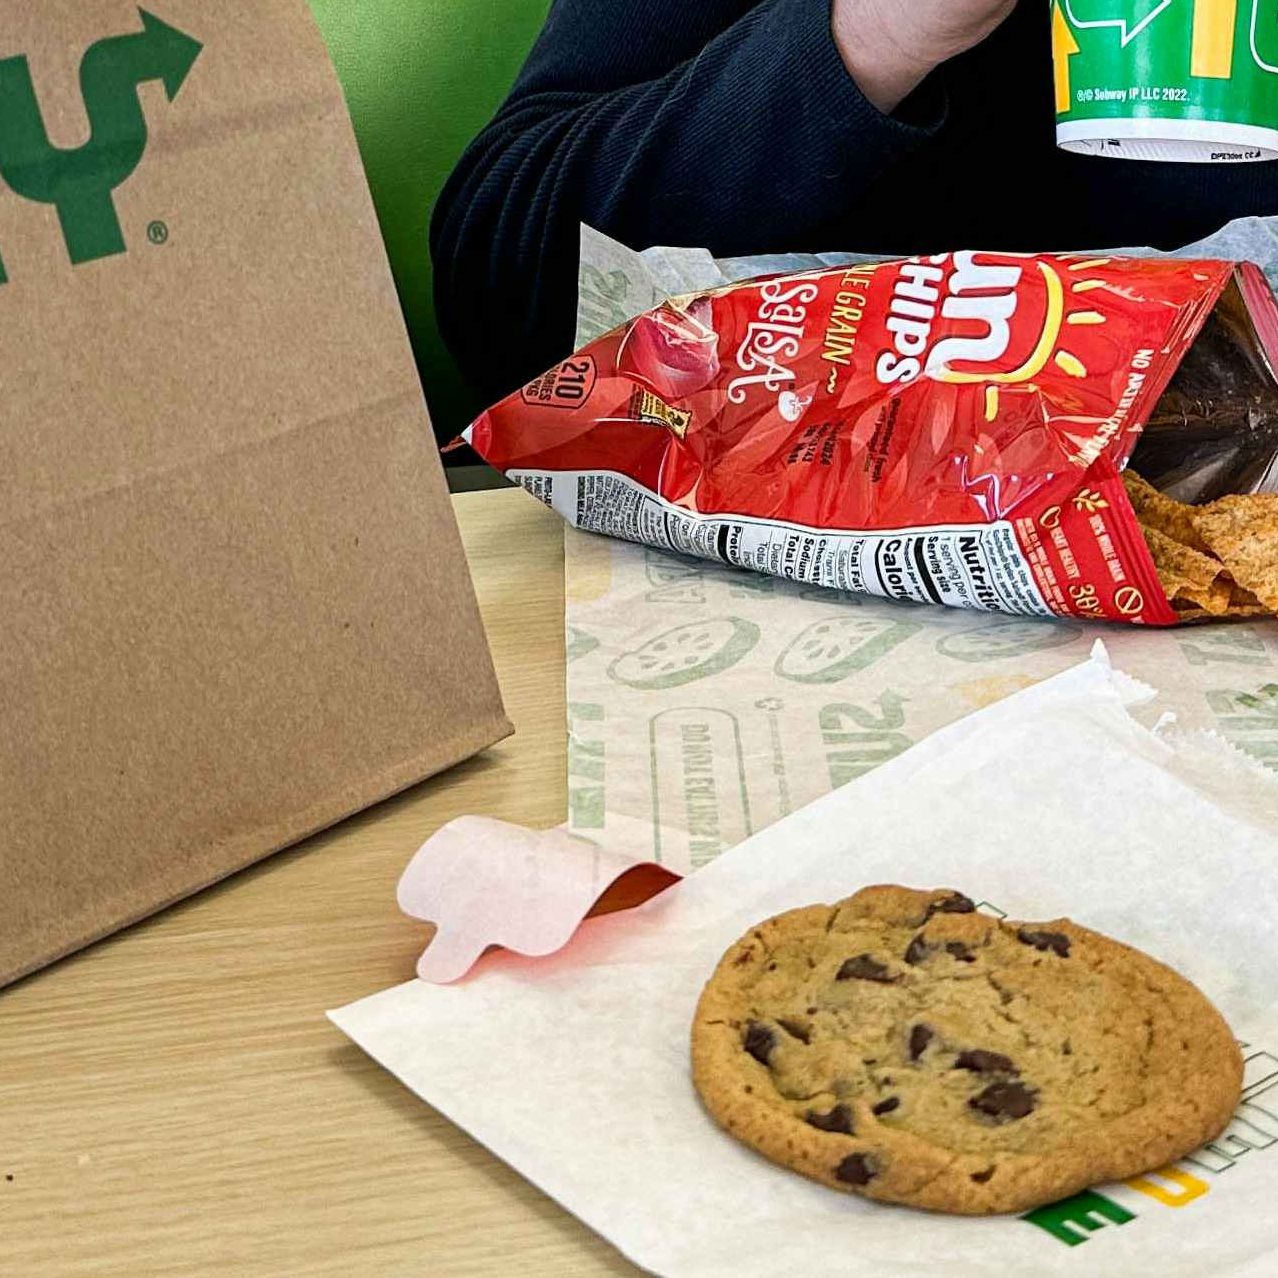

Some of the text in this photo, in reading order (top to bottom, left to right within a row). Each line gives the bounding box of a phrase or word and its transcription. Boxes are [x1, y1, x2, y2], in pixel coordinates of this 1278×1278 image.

[1094, 88, 1126, 102] Subway
[1129, 87, 1139, 100] IP
[1141, 88, 1160, 100] LLC
[821, 290, 867, 366] GRAIN
[876, 255, 944, 384] HIPS
[924, 250, 1023, 377] un
[554, 361, 590, 399] 210
[1129, 349, 1154, 369] NO
[785, 534, 800, 567] Total
[798, 537, 814, 579] Sodium
[851, 539, 865, 589] Total Fat
[883, 539, 913, 603] Calori
[927, 536, 951, 593] Serving size
[940, 543, 961, 582] serving
[955, 581, 969, 599] per
[959, 536, 1001, 611] Nutritio
